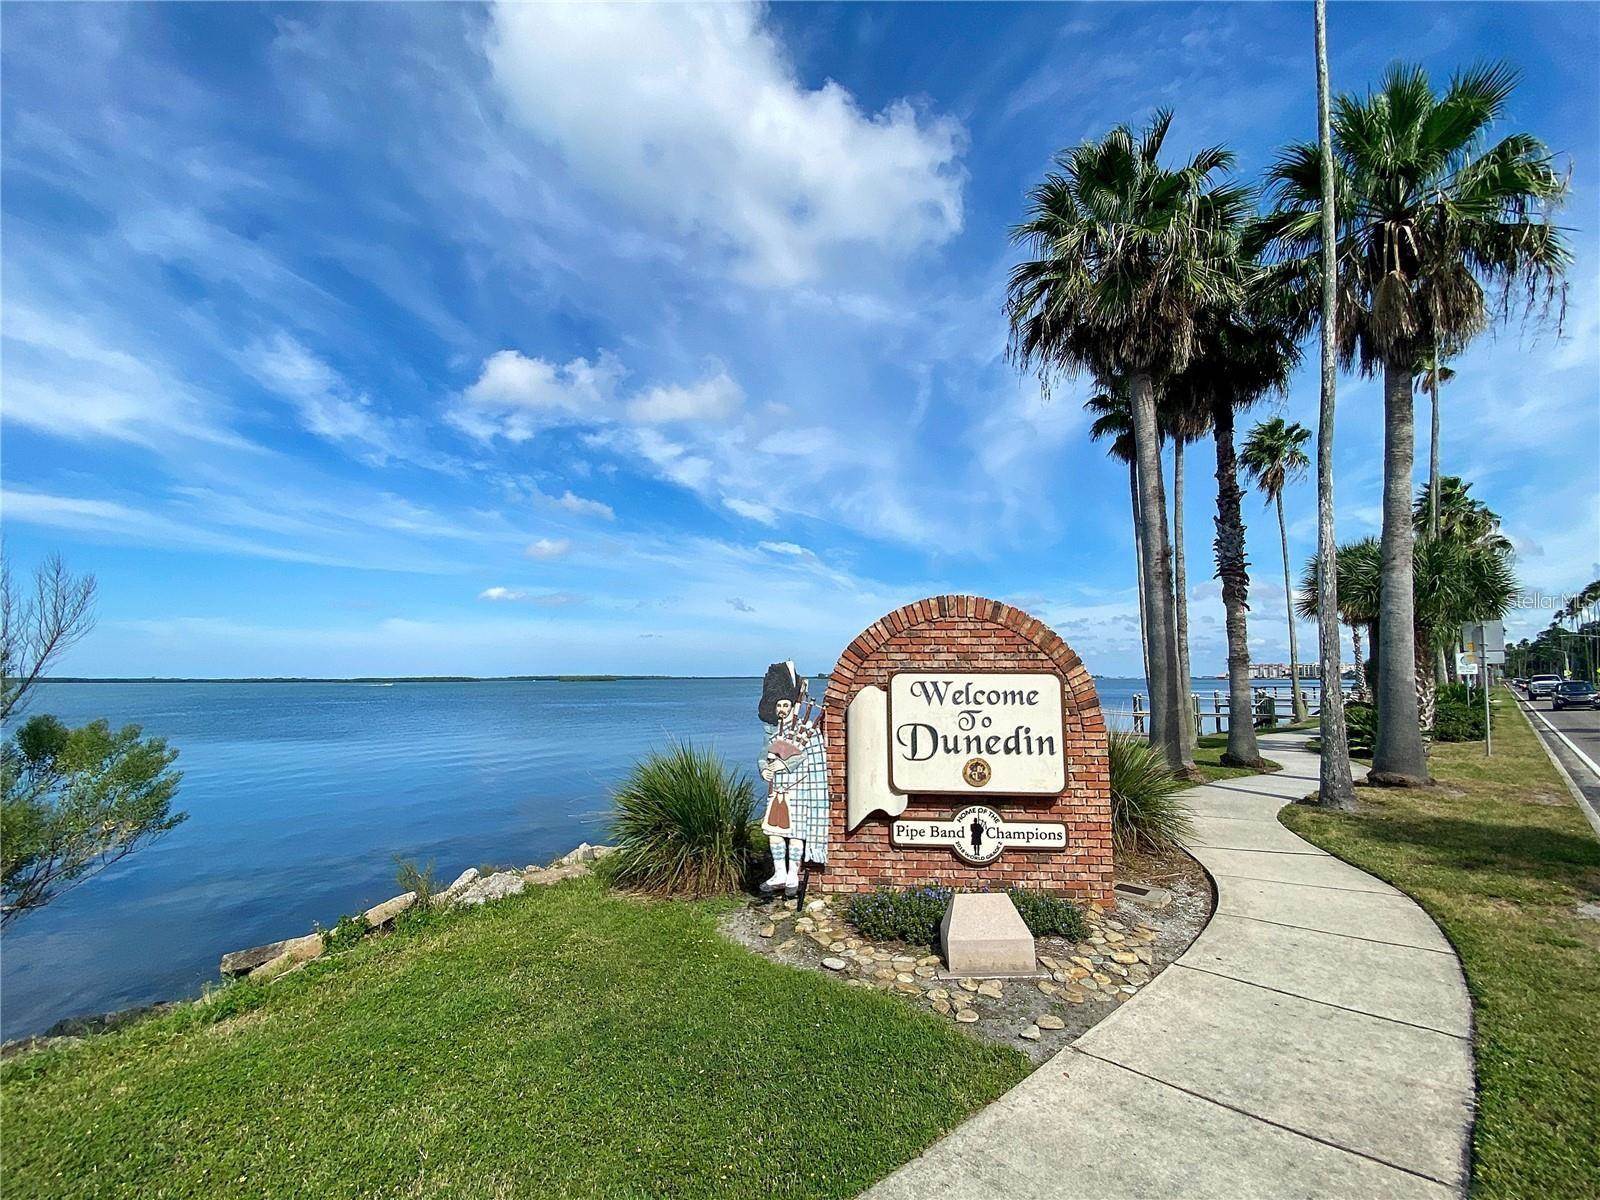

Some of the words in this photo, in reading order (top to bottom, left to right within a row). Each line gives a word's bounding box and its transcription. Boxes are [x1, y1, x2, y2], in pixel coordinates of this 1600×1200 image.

[910, 680, 1040, 706] Welcome
[958, 710, 992, 731] To
[896, 723, 1056, 761] Dunedin
[957, 808, 976, 823] HOME
[988, 811, 1000, 824] THE
[896, 825, 926, 840] Pipe
[930, 825, 965, 839] Band
[985, 826, 1063, 843] Champions
[964, 851, 985, 860] WORLD
